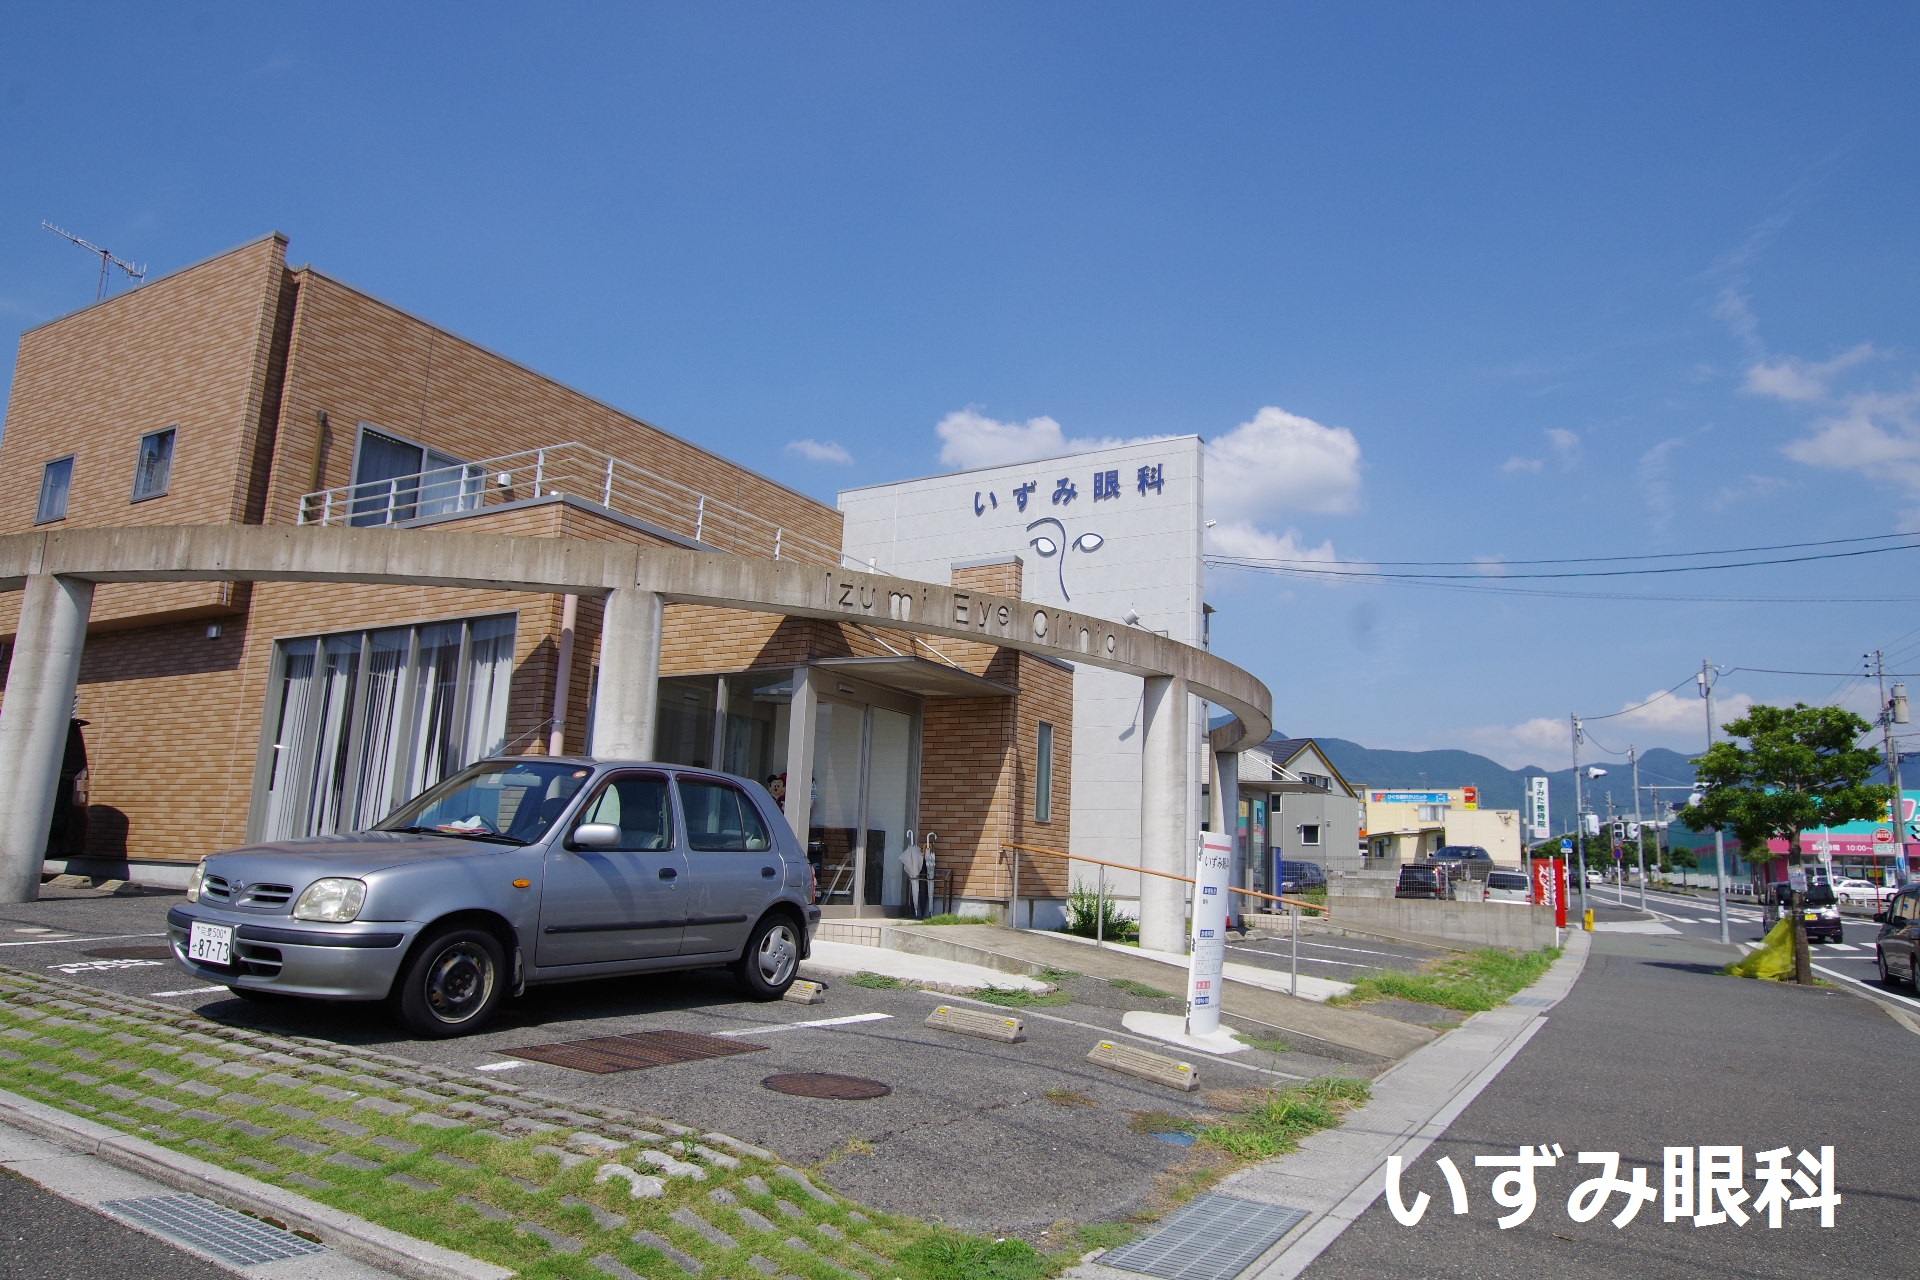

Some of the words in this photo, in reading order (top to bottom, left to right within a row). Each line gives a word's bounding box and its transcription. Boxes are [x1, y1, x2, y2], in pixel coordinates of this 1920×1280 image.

[974, 463, 1165, 517] いずみ眼科
[825, 572, 928, 621] Izumi
[954, 593, 1010, 627] Eye
[1033, 609, 1116, 654] Clinic
[1536, 781, 1546, 828] すみだ整骨院
[1205, 856, 1230, 870] いずみ眼
[198, 938, 229, 961] 87-73
